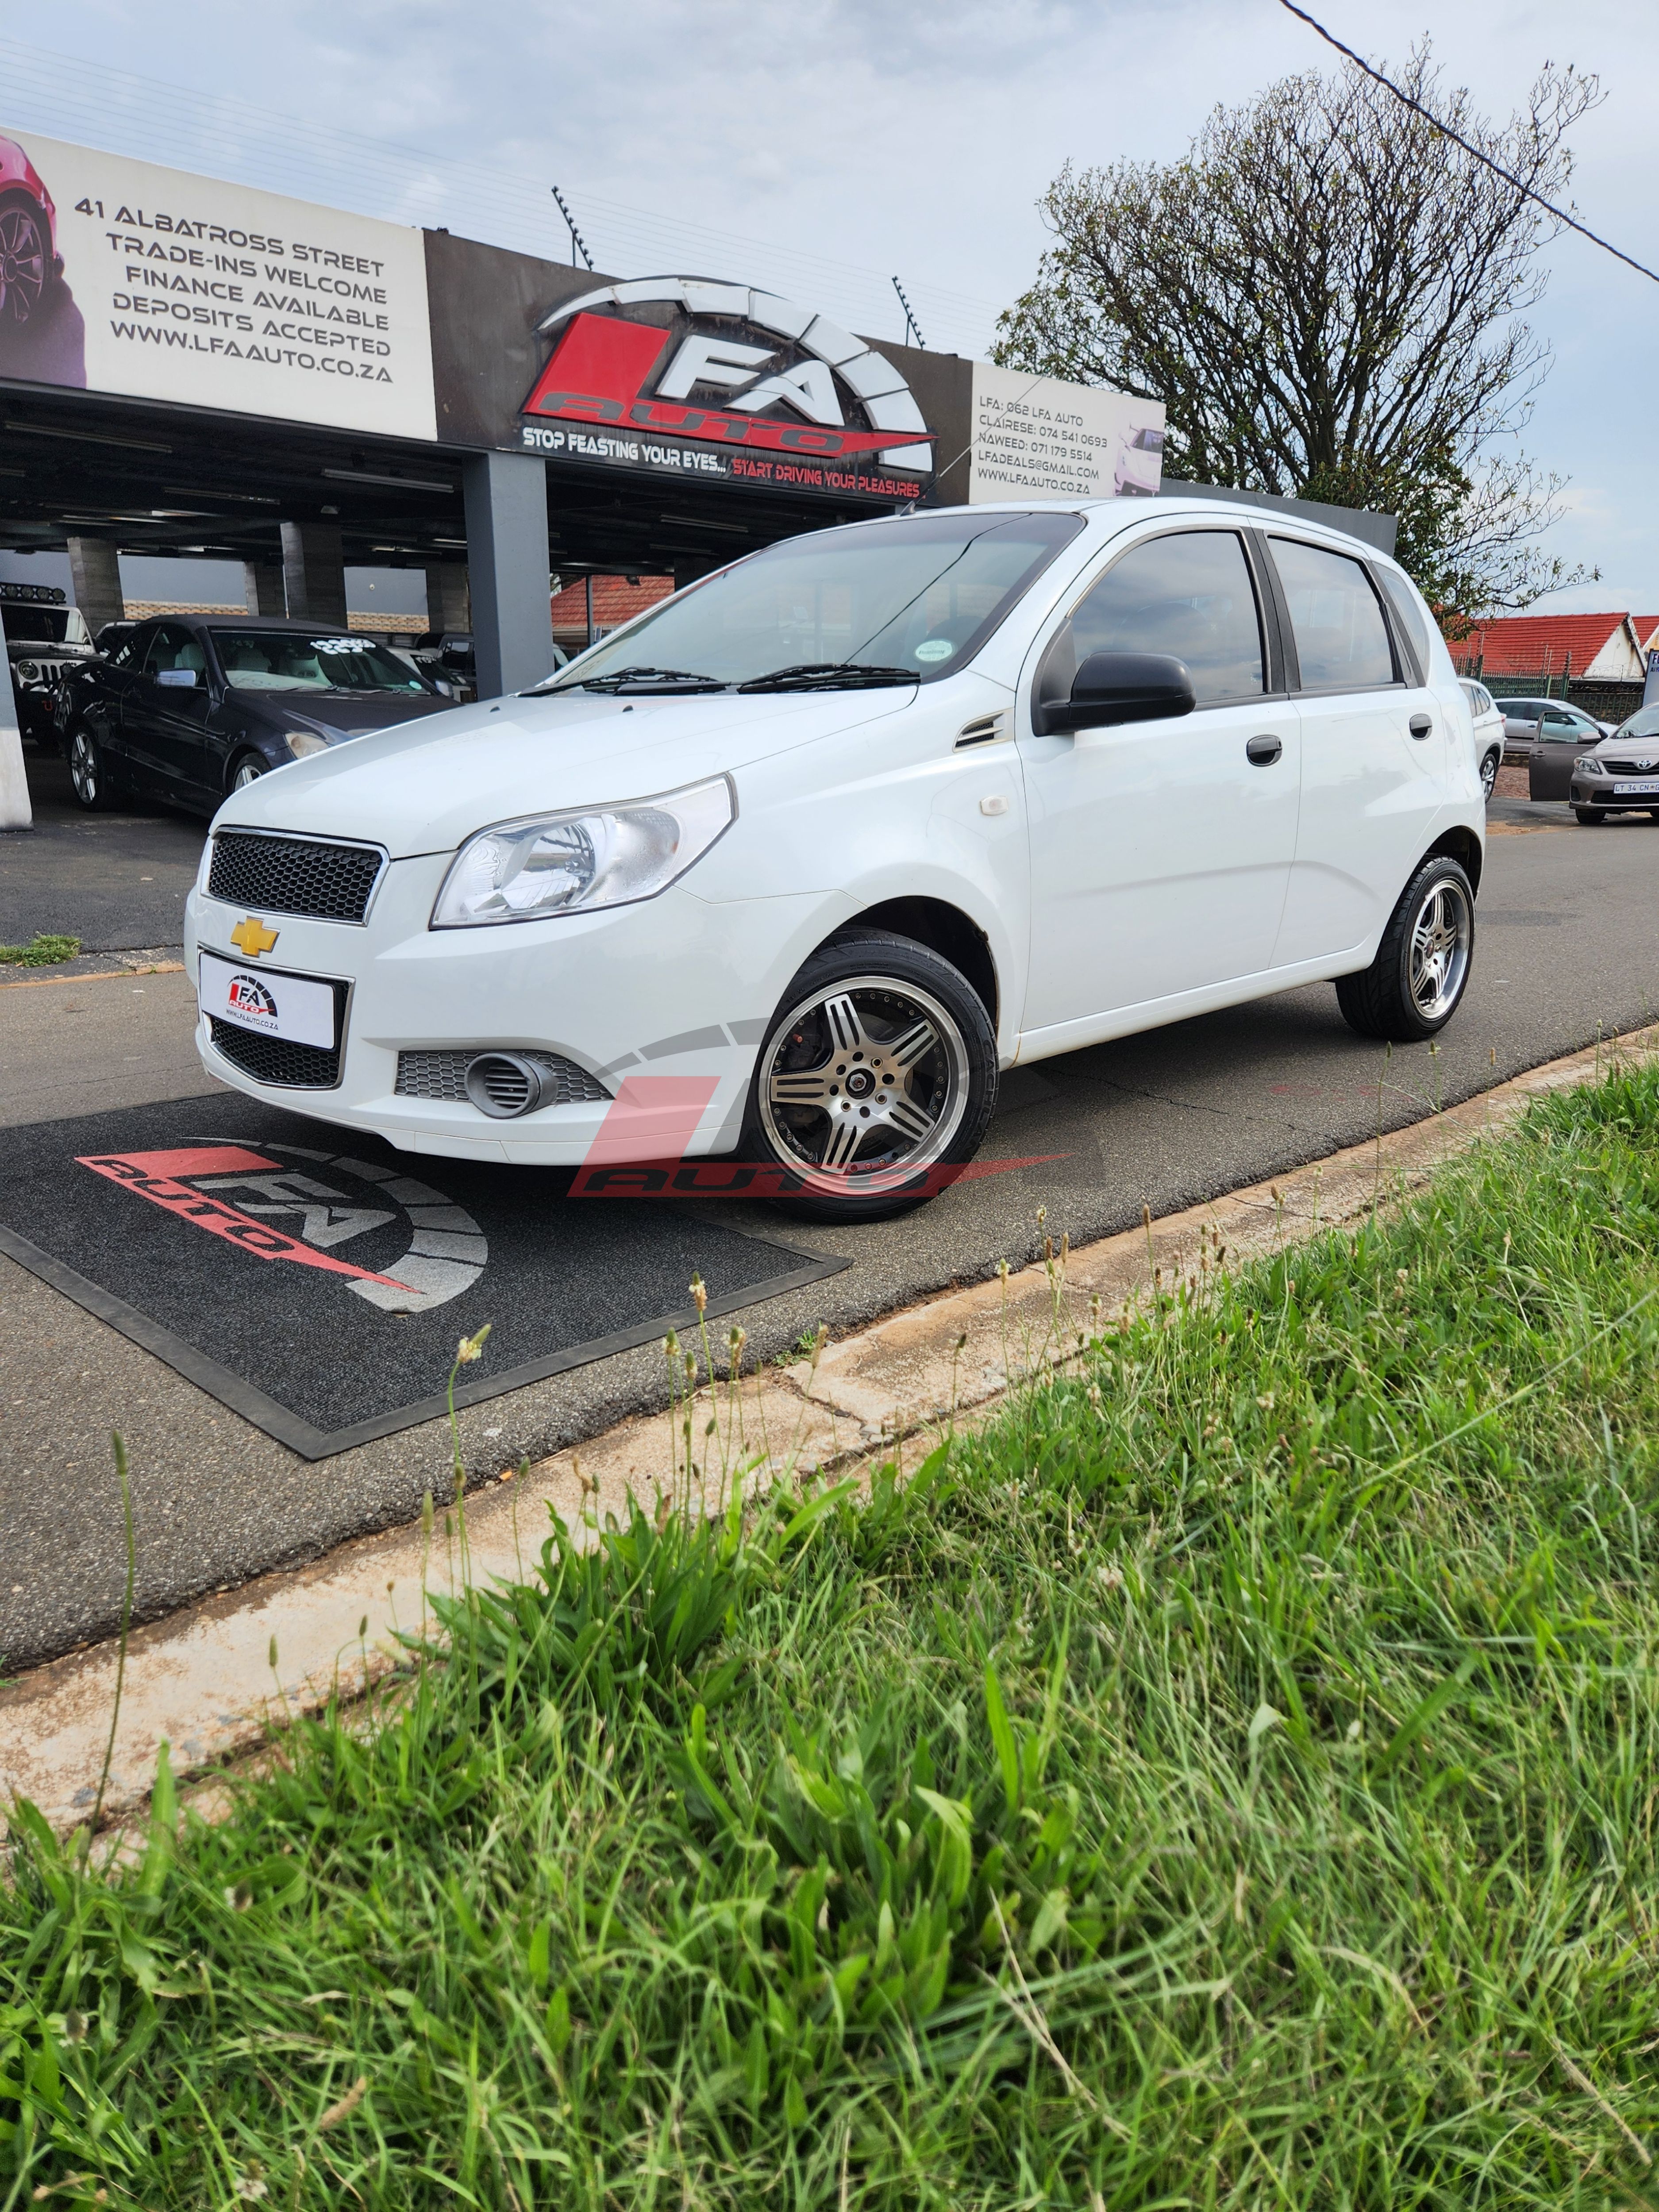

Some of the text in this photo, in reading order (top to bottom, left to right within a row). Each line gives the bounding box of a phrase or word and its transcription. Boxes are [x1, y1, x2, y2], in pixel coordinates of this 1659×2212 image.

[74, 198, 384, 277] 41 ALBATROSS STREET
[105, 232, 387, 305] TRADE-INS WELCOME
[126, 265, 389, 331] FINANCE AVAILABLE
[110, 320, 394, 384] WWW.LFAAUTO.CO.ZA
[113, 293, 391, 356] DEPOSITS ACCEPTED
[538, 392, 844, 451] AUTO
[979, 415, 1107, 448] CLAIRESE: 074 541 0693
[980, 396, 1083, 426] LFA: 062 LFA AUTO
[523, 427, 565, 449] STOP
[568, 433, 639, 461] FEASTING
[641, 444, 680, 466] YOUR
[732, 458, 774, 478] START
[776, 464, 822, 485] DRIVING
[824, 471, 855, 489] YOUR
[978, 450, 1099, 480] LFADEALS@GMAIL.COM
[979, 432, 1093, 462] NAWEED: 071 179 5514
[978, 467, 1090, 494] WWW.LFAAUTO.CO.ZA
[229, 983, 260, 1007] LFA
[229, 1000, 259, 1013] AUTO
[89, 1159, 296, 1253] AUTO
